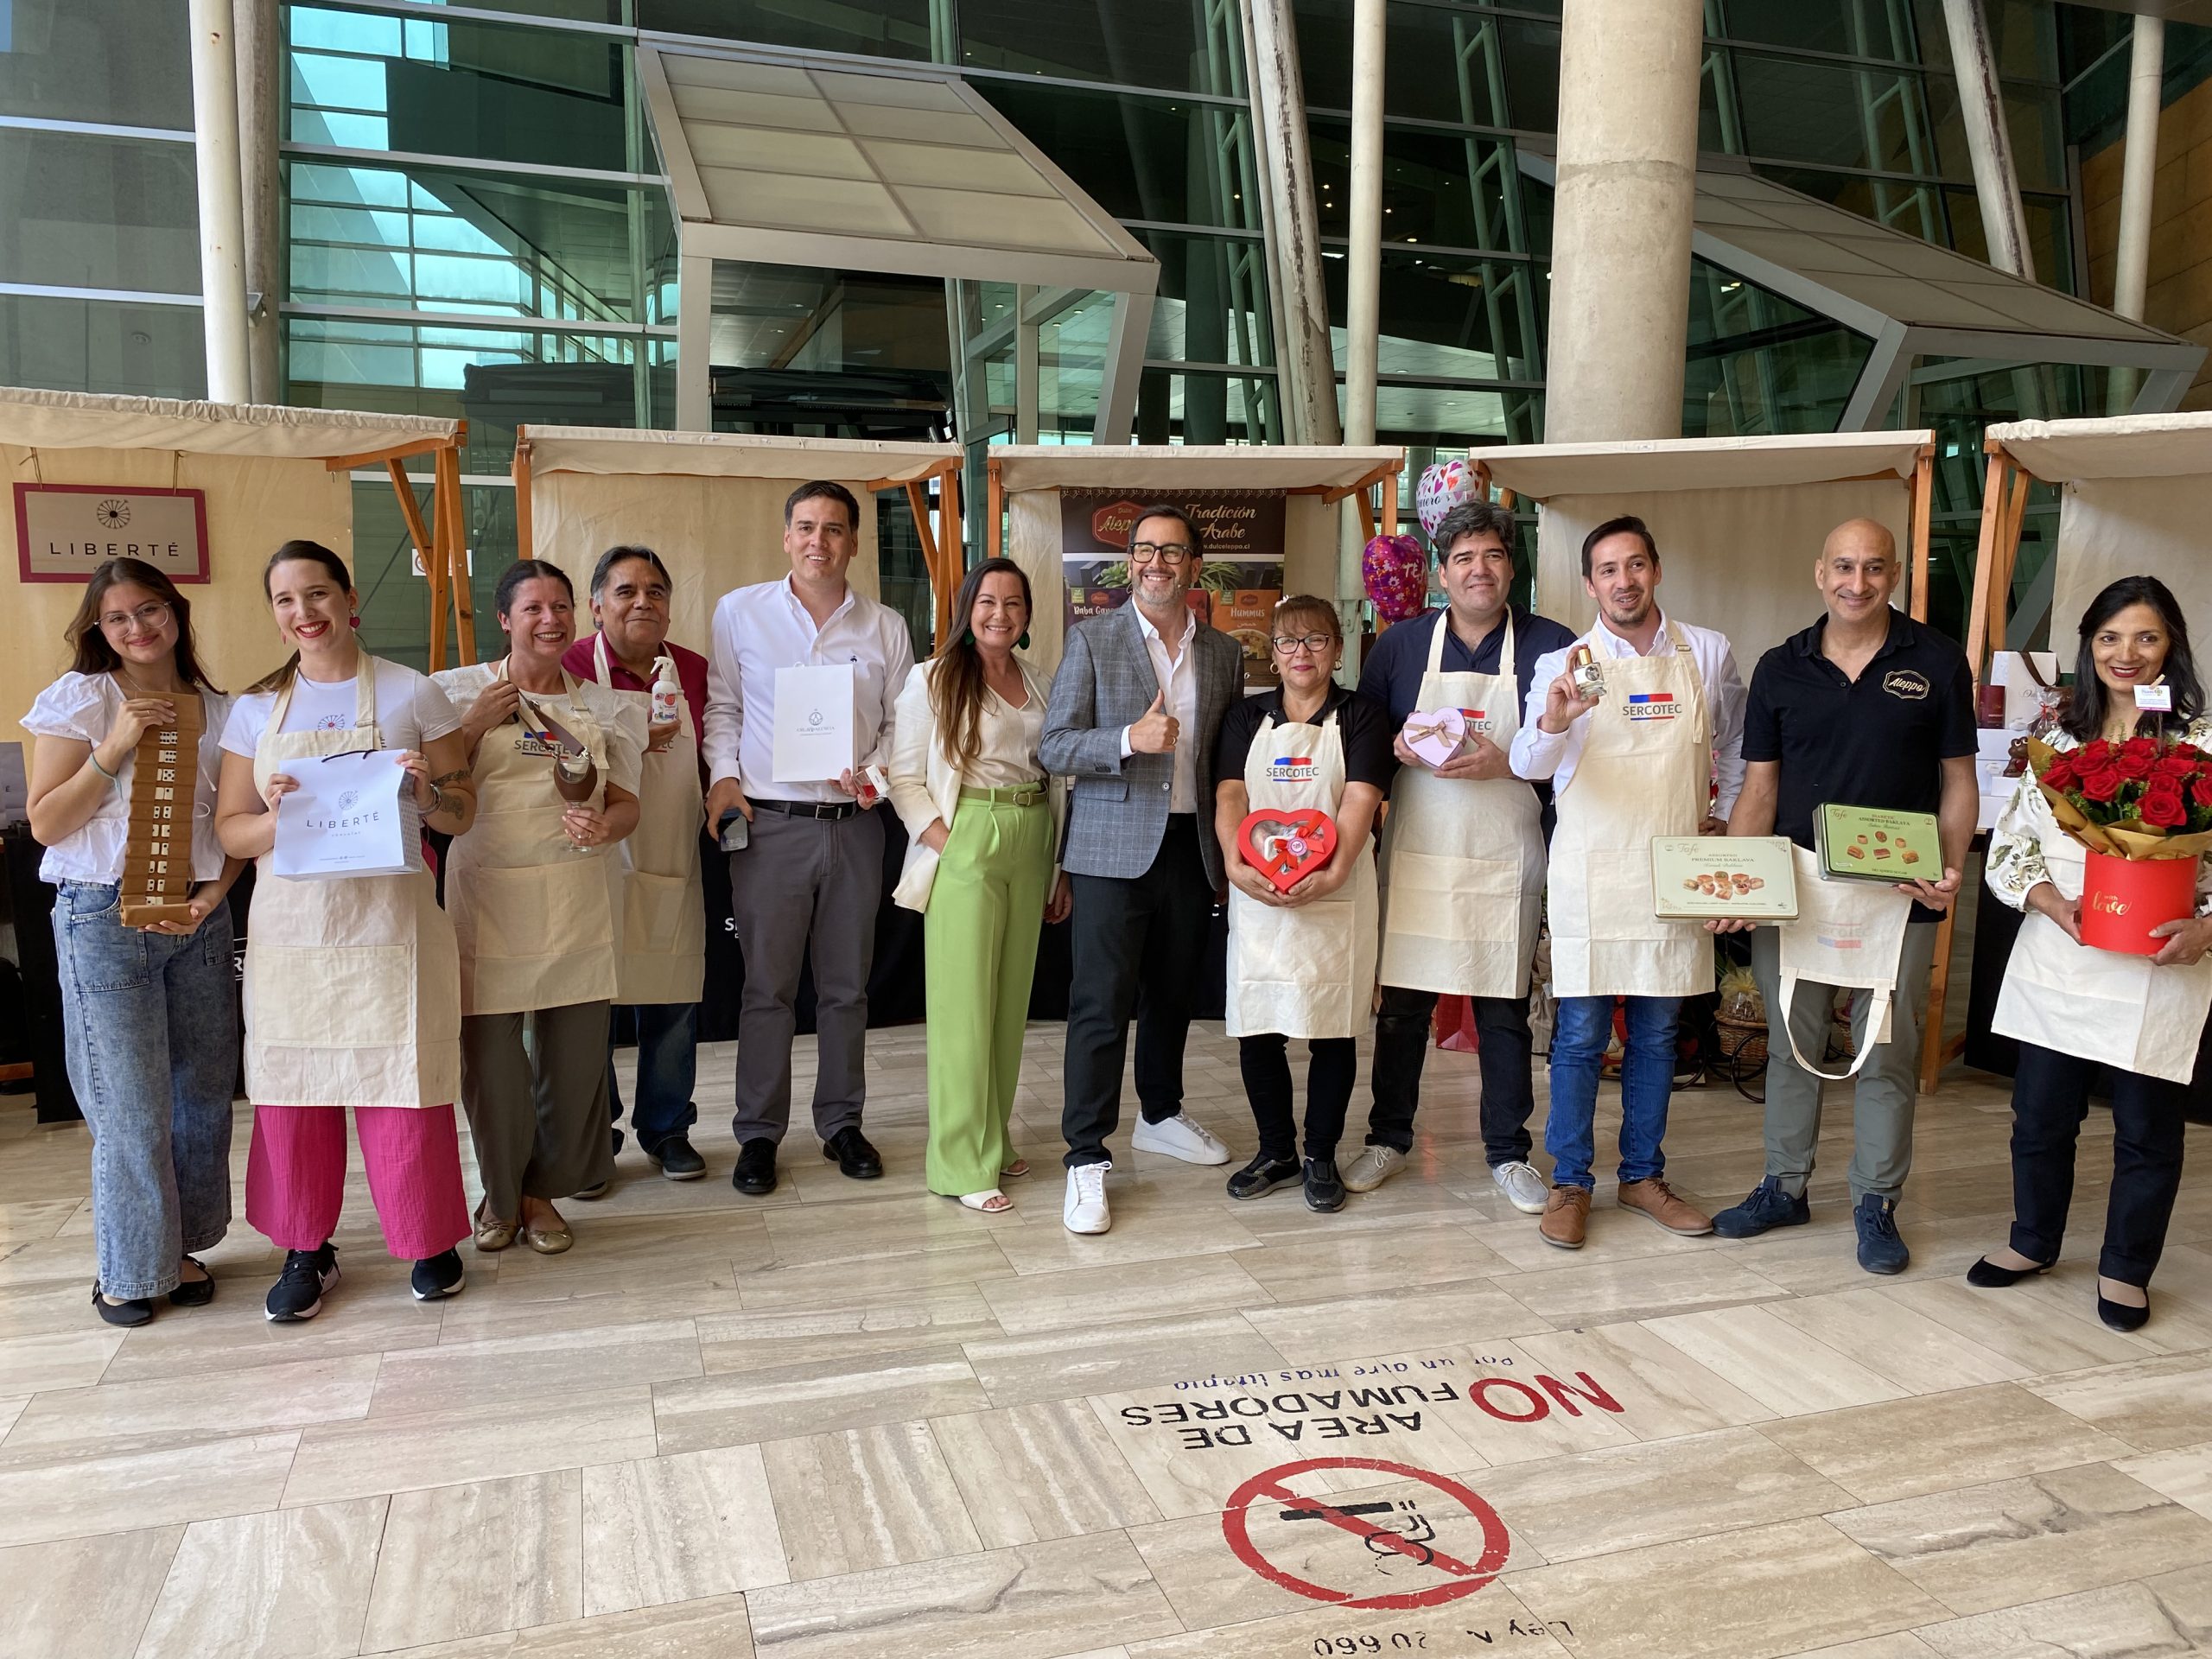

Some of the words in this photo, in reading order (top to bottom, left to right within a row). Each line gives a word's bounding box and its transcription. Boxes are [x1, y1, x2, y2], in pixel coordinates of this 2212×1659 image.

[49, 542, 180, 557] LIBERTÉ
[1073, 605, 1094, 616] Baba
[1230, 607, 1265, 619] Hummus
[1888, 677, 1925, 692] Aleppo
[1622, 703, 1682, 716] SERCOTEC
[1266, 766, 1319, 778] SERCOTEC
[307, 811, 380, 829] LIBERTÉ
[2093, 890, 2133, 916] love
[1420, 1358, 1455, 1370] un
[1280, 1368, 1340, 1382] mas
[1120, 1382, 1460, 1427] FUMADORES
[1469, 1371, 1625, 1423] NO
[1268, 1410, 1423, 1441] AREA
[1177, 1424, 1252, 1450] DE
